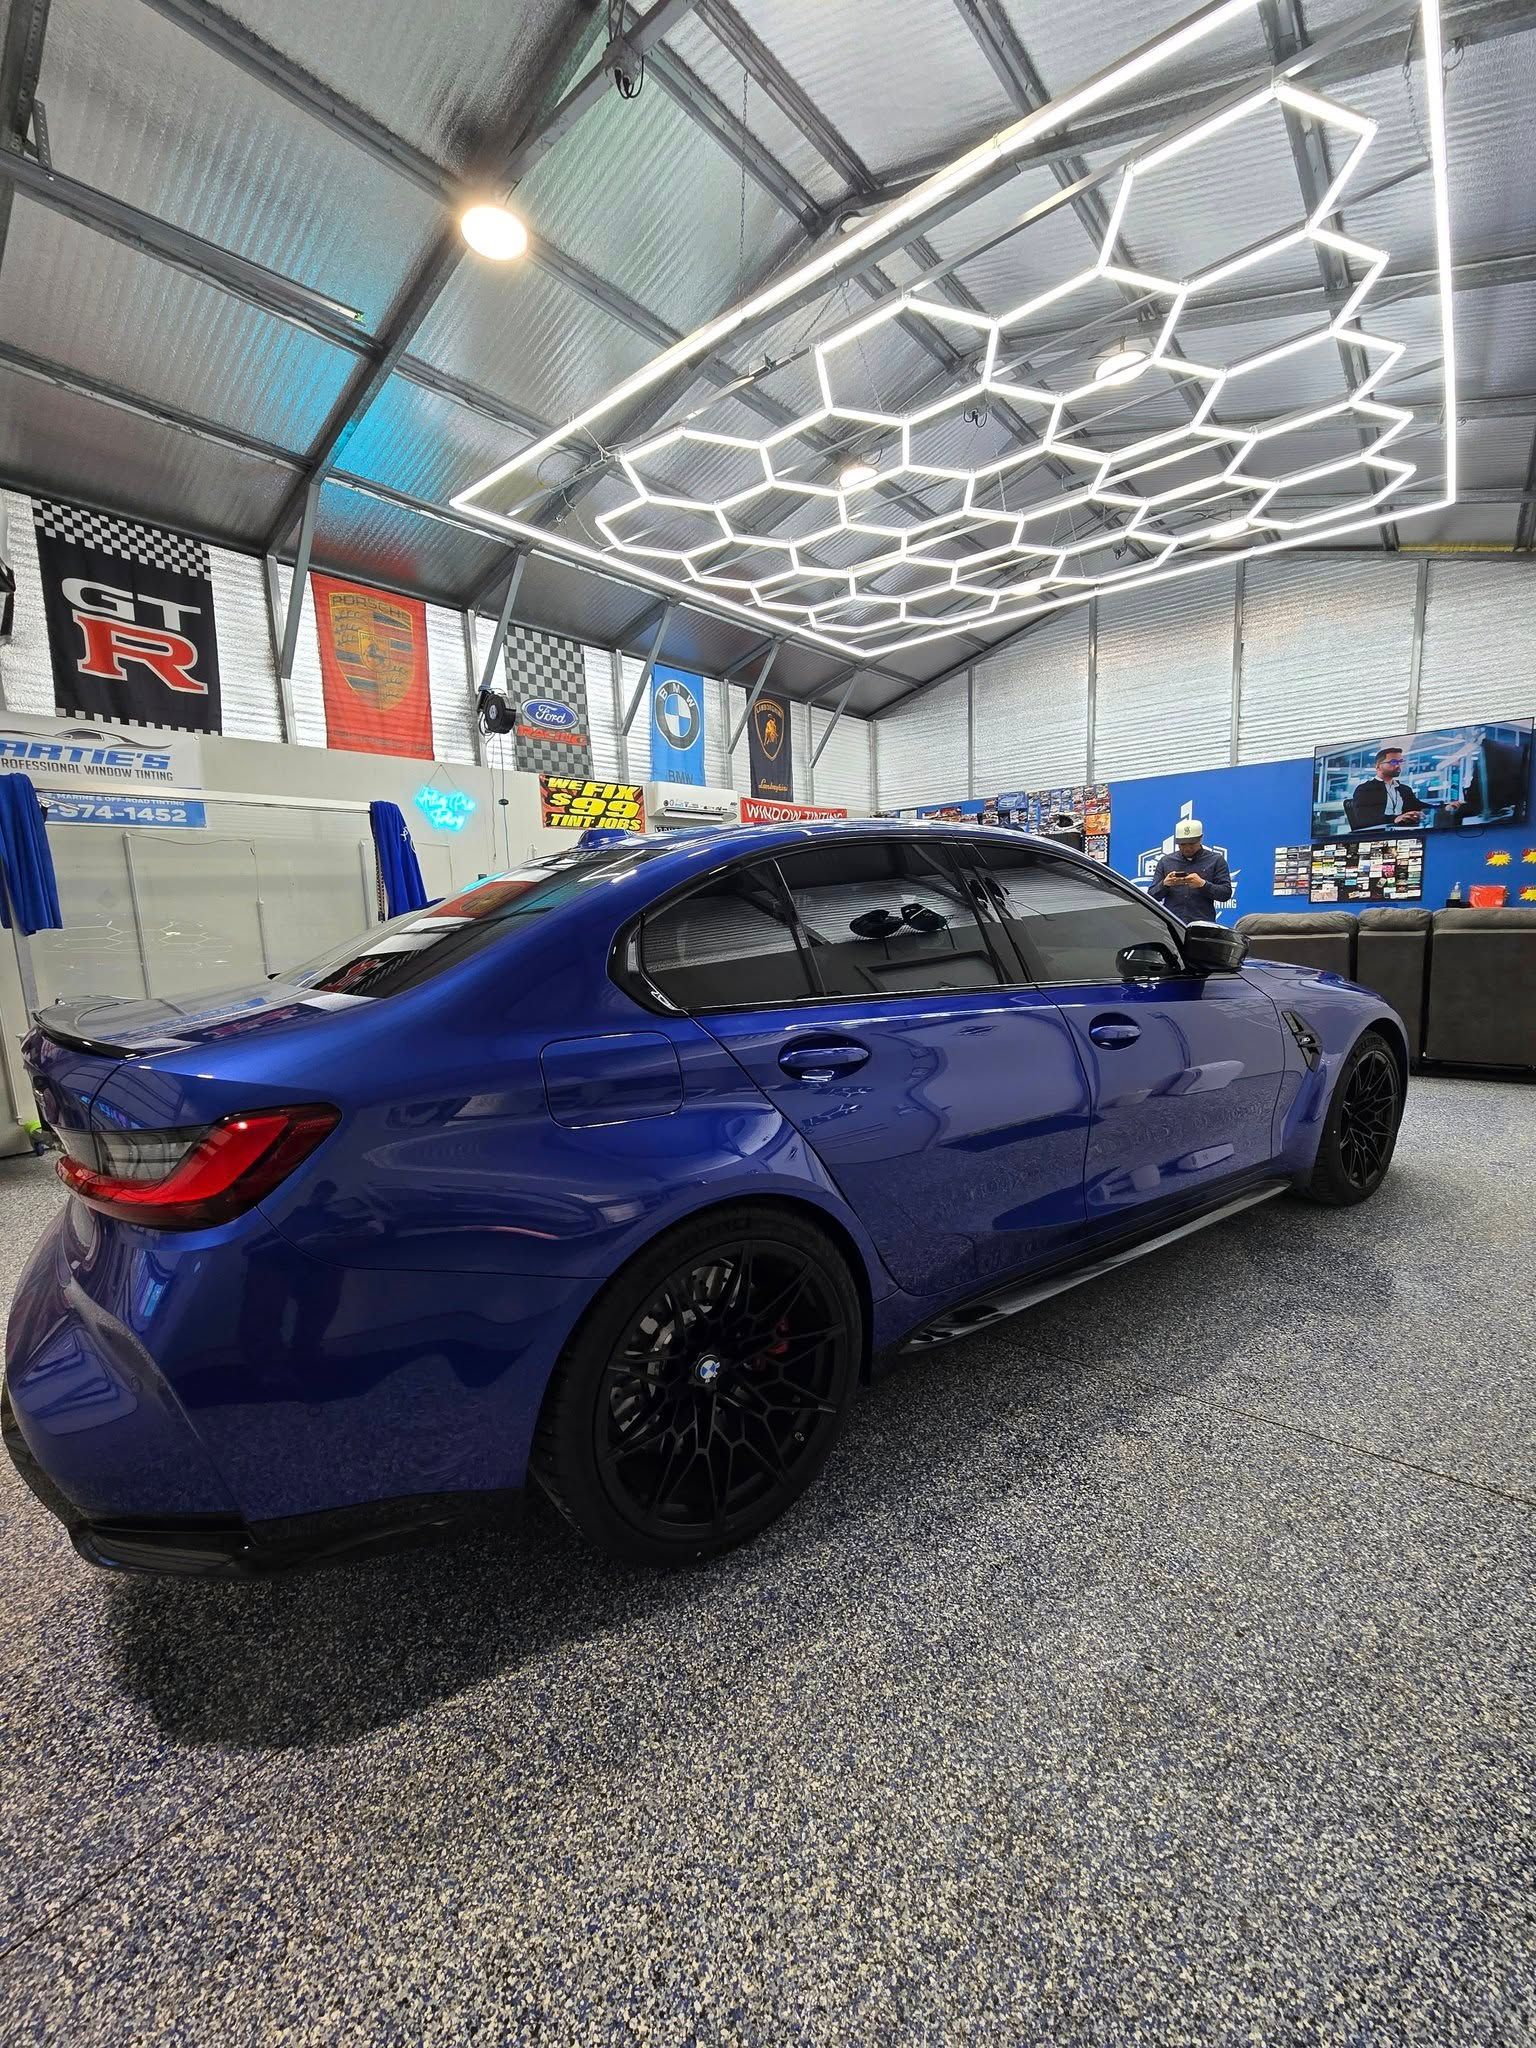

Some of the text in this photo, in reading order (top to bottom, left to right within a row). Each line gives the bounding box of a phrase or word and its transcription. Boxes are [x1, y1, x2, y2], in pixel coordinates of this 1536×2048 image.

[61, 577, 201, 631] GT
[332, 595, 411, 620] PORSCHE
[71, 609, 209, 695] R
[659, 682, 695, 708] BMW
[535, 704, 567, 724] Ford
[85, 765, 132, 779] WINDOW
[134, 769, 173, 782] TINTING
[547, 777, 640, 801] WE FIX
[550, 814, 596, 828] TINT
[595, 817, 642, 831] JOBS
[746, 802, 802, 821] WINDOW
